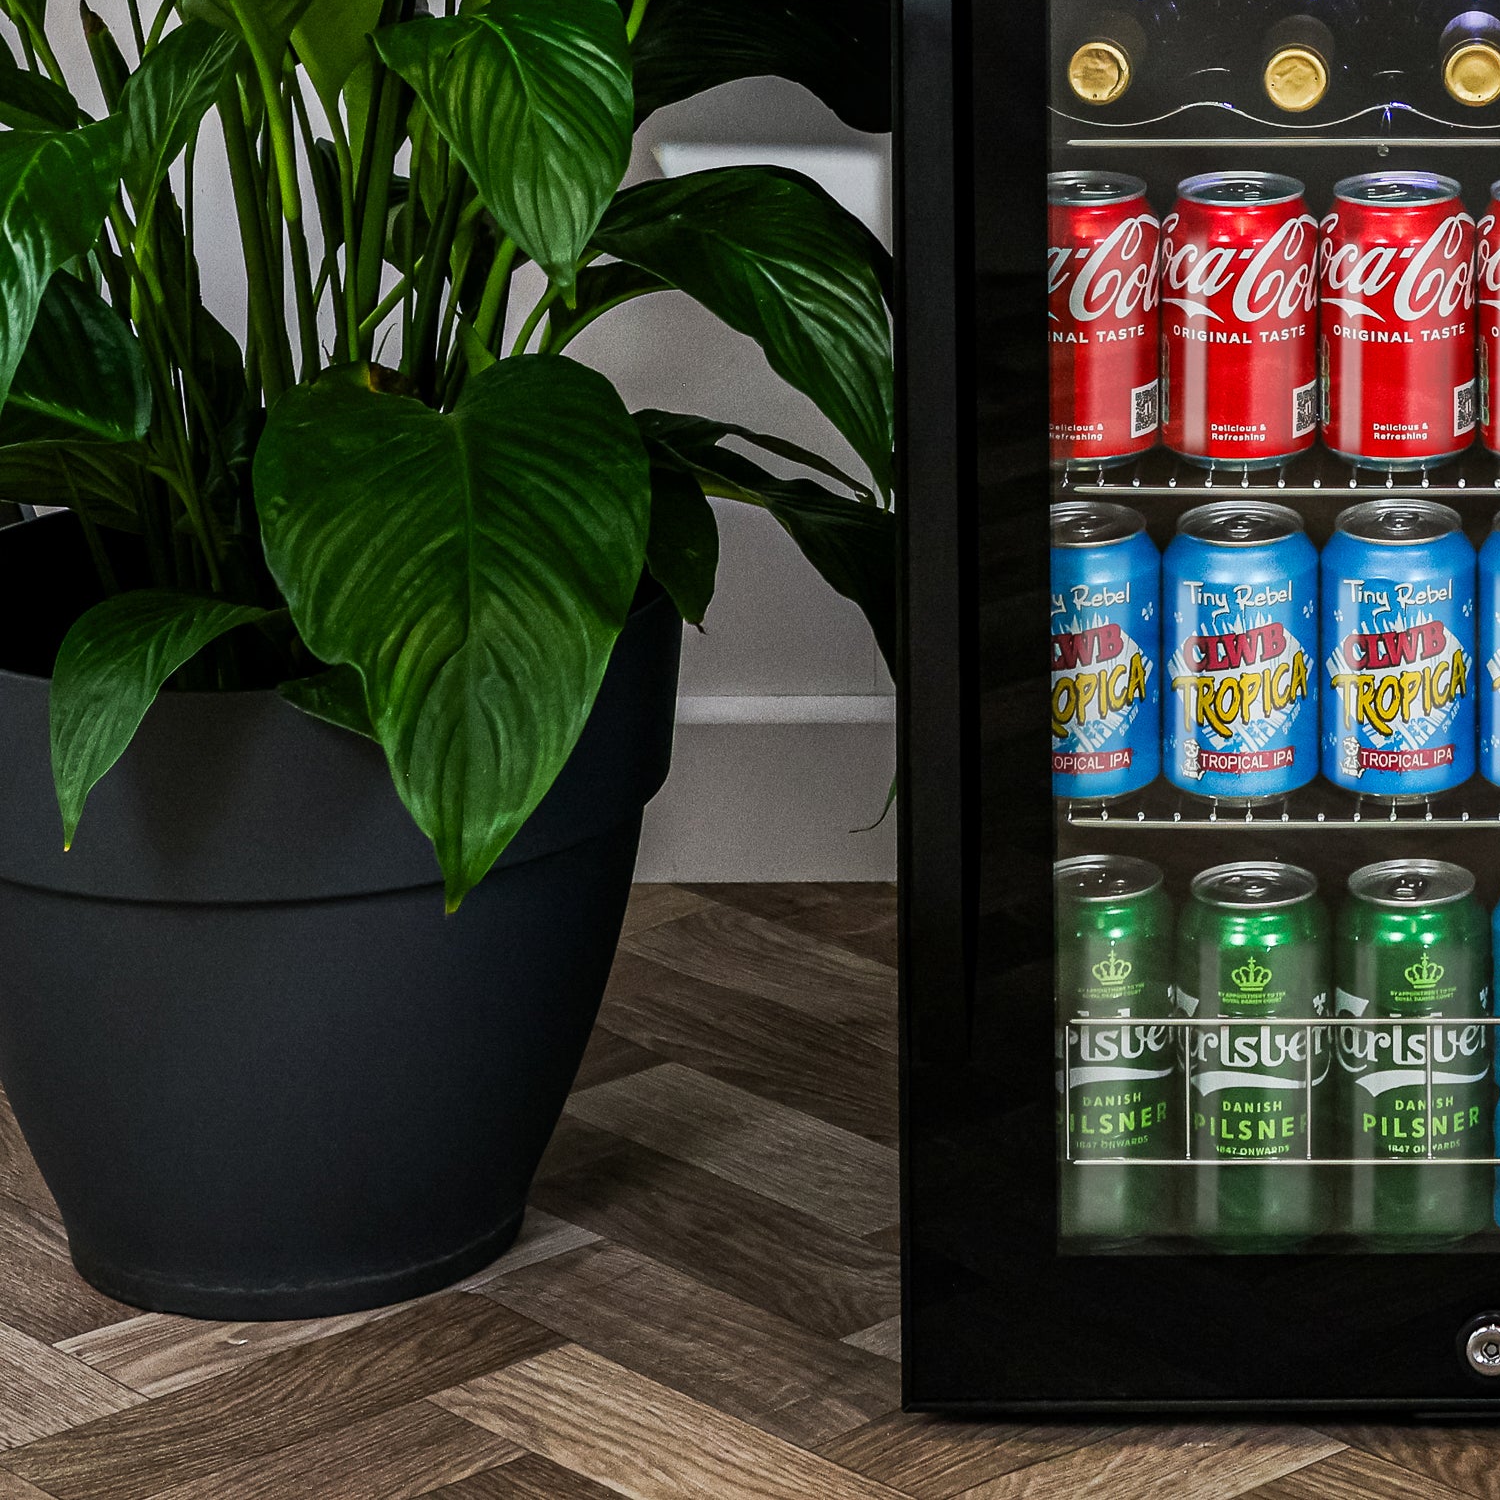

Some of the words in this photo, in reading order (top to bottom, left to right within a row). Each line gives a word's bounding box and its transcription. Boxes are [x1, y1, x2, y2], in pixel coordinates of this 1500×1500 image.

[1173, 325, 1252, 344] ORIGINAL
[1259, 324, 1306, 343] TASTE
[1333, 325, 1413, 343] ORIGINAL
[1421, 323, 1466, 341] TASTE
[1211, 423, 1257, 432] Delicious
[1211, 432, 1266, 441] Refreshing
[1373, 423, 1420, 431] Delicious
[1373, 432, 1428, 441] Refreshing
[1183, 580, 1230, 620] Tiny
[1234, 580, 1293, 609] Rebel
[1343, 579, 1392, 619] Tiny
[1395, 579, 1453, 608] Rebel
[1183, 622, 1287, 673] CLWB
[1343, 620, 1447, 671] CLWB
[1172, 650, 1308, 739] TROPICA
[1331, 649, 1467, 736] TROPICA
[1201, 752, 1268, 769] TROPICAL
[1273, 749, 1293, 766] IPA
[1361, 751, 1428, 767] TROPICAL
[1433, 748, 1453, 764] IPA
[1083, 1092, 1142, 1107] DANISH
[1223, 1100, 1282, 1112] DANISH
[1363, 1106, 1480, 1139] PILSNER
